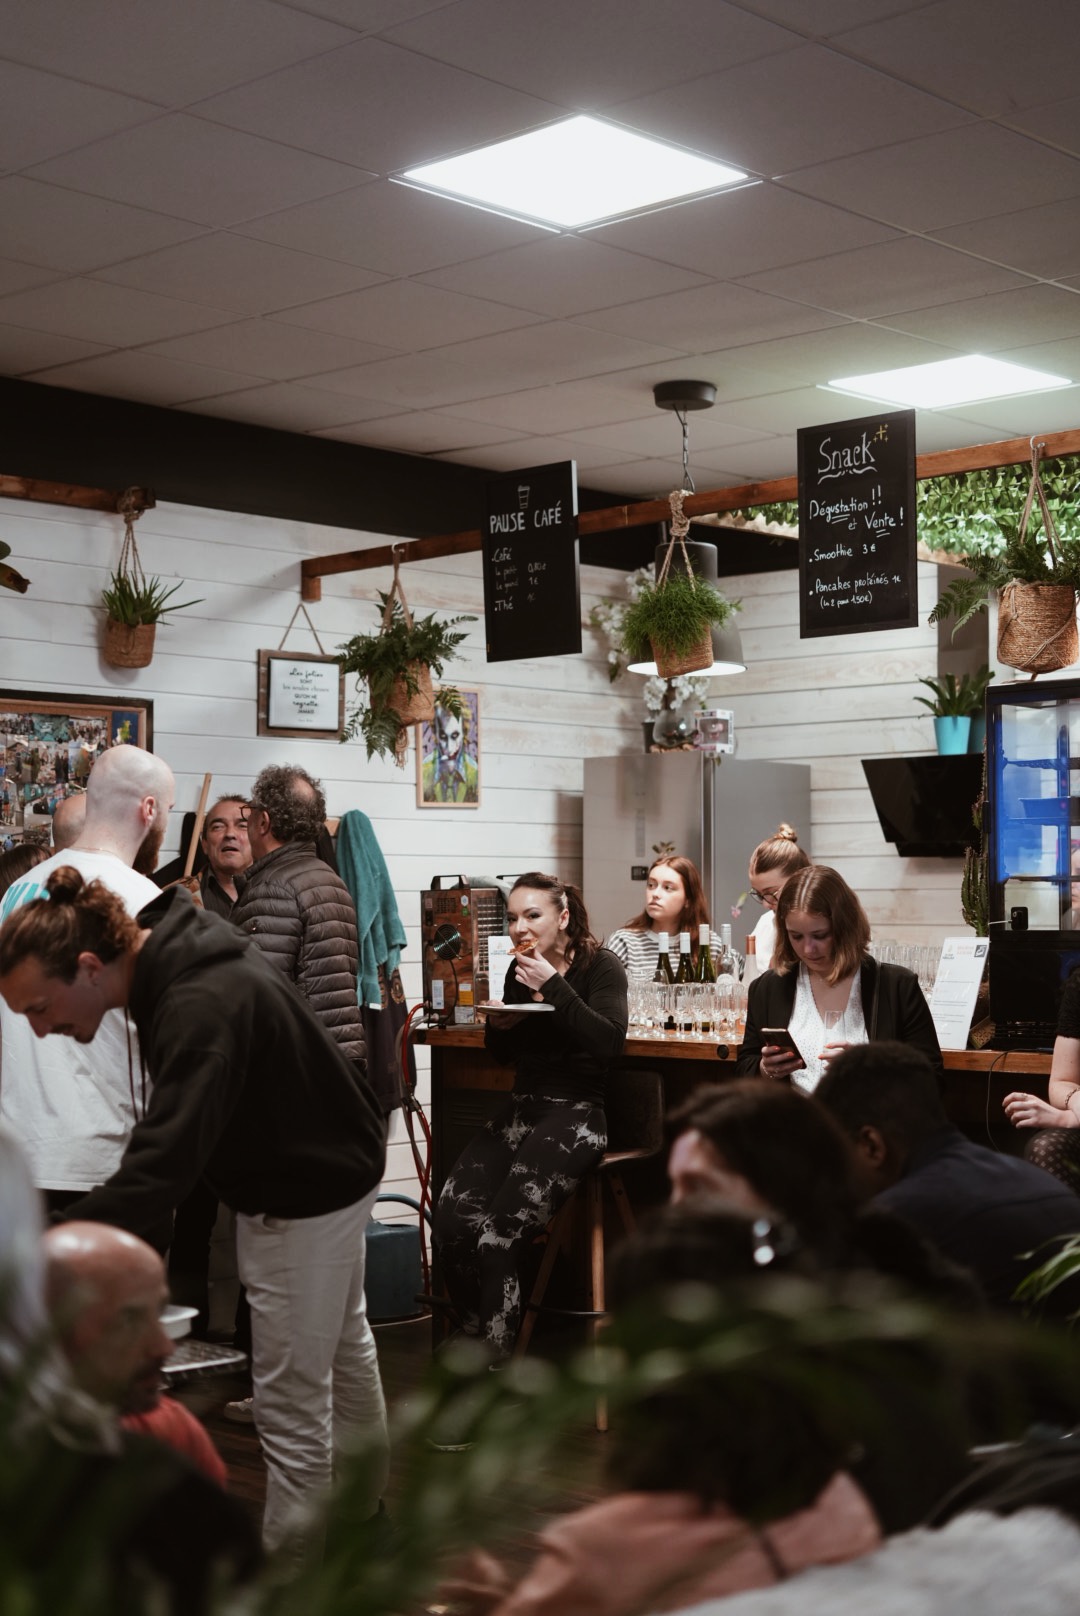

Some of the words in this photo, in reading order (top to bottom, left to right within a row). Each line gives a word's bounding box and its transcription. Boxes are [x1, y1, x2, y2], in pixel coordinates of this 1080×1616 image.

[818, 432, 876, 474] Snack
[489, 512, 526, 534] PAUSE
[534, 500, 562, 528] CAFÉ
[848, 517, 857, 531] et
[494, 547, 512, 563] Café
[814, 543, 853, 561] Smoothie
[815, 576, 851, 594] Pancakes
[495, 596, 514, 611] Thé
